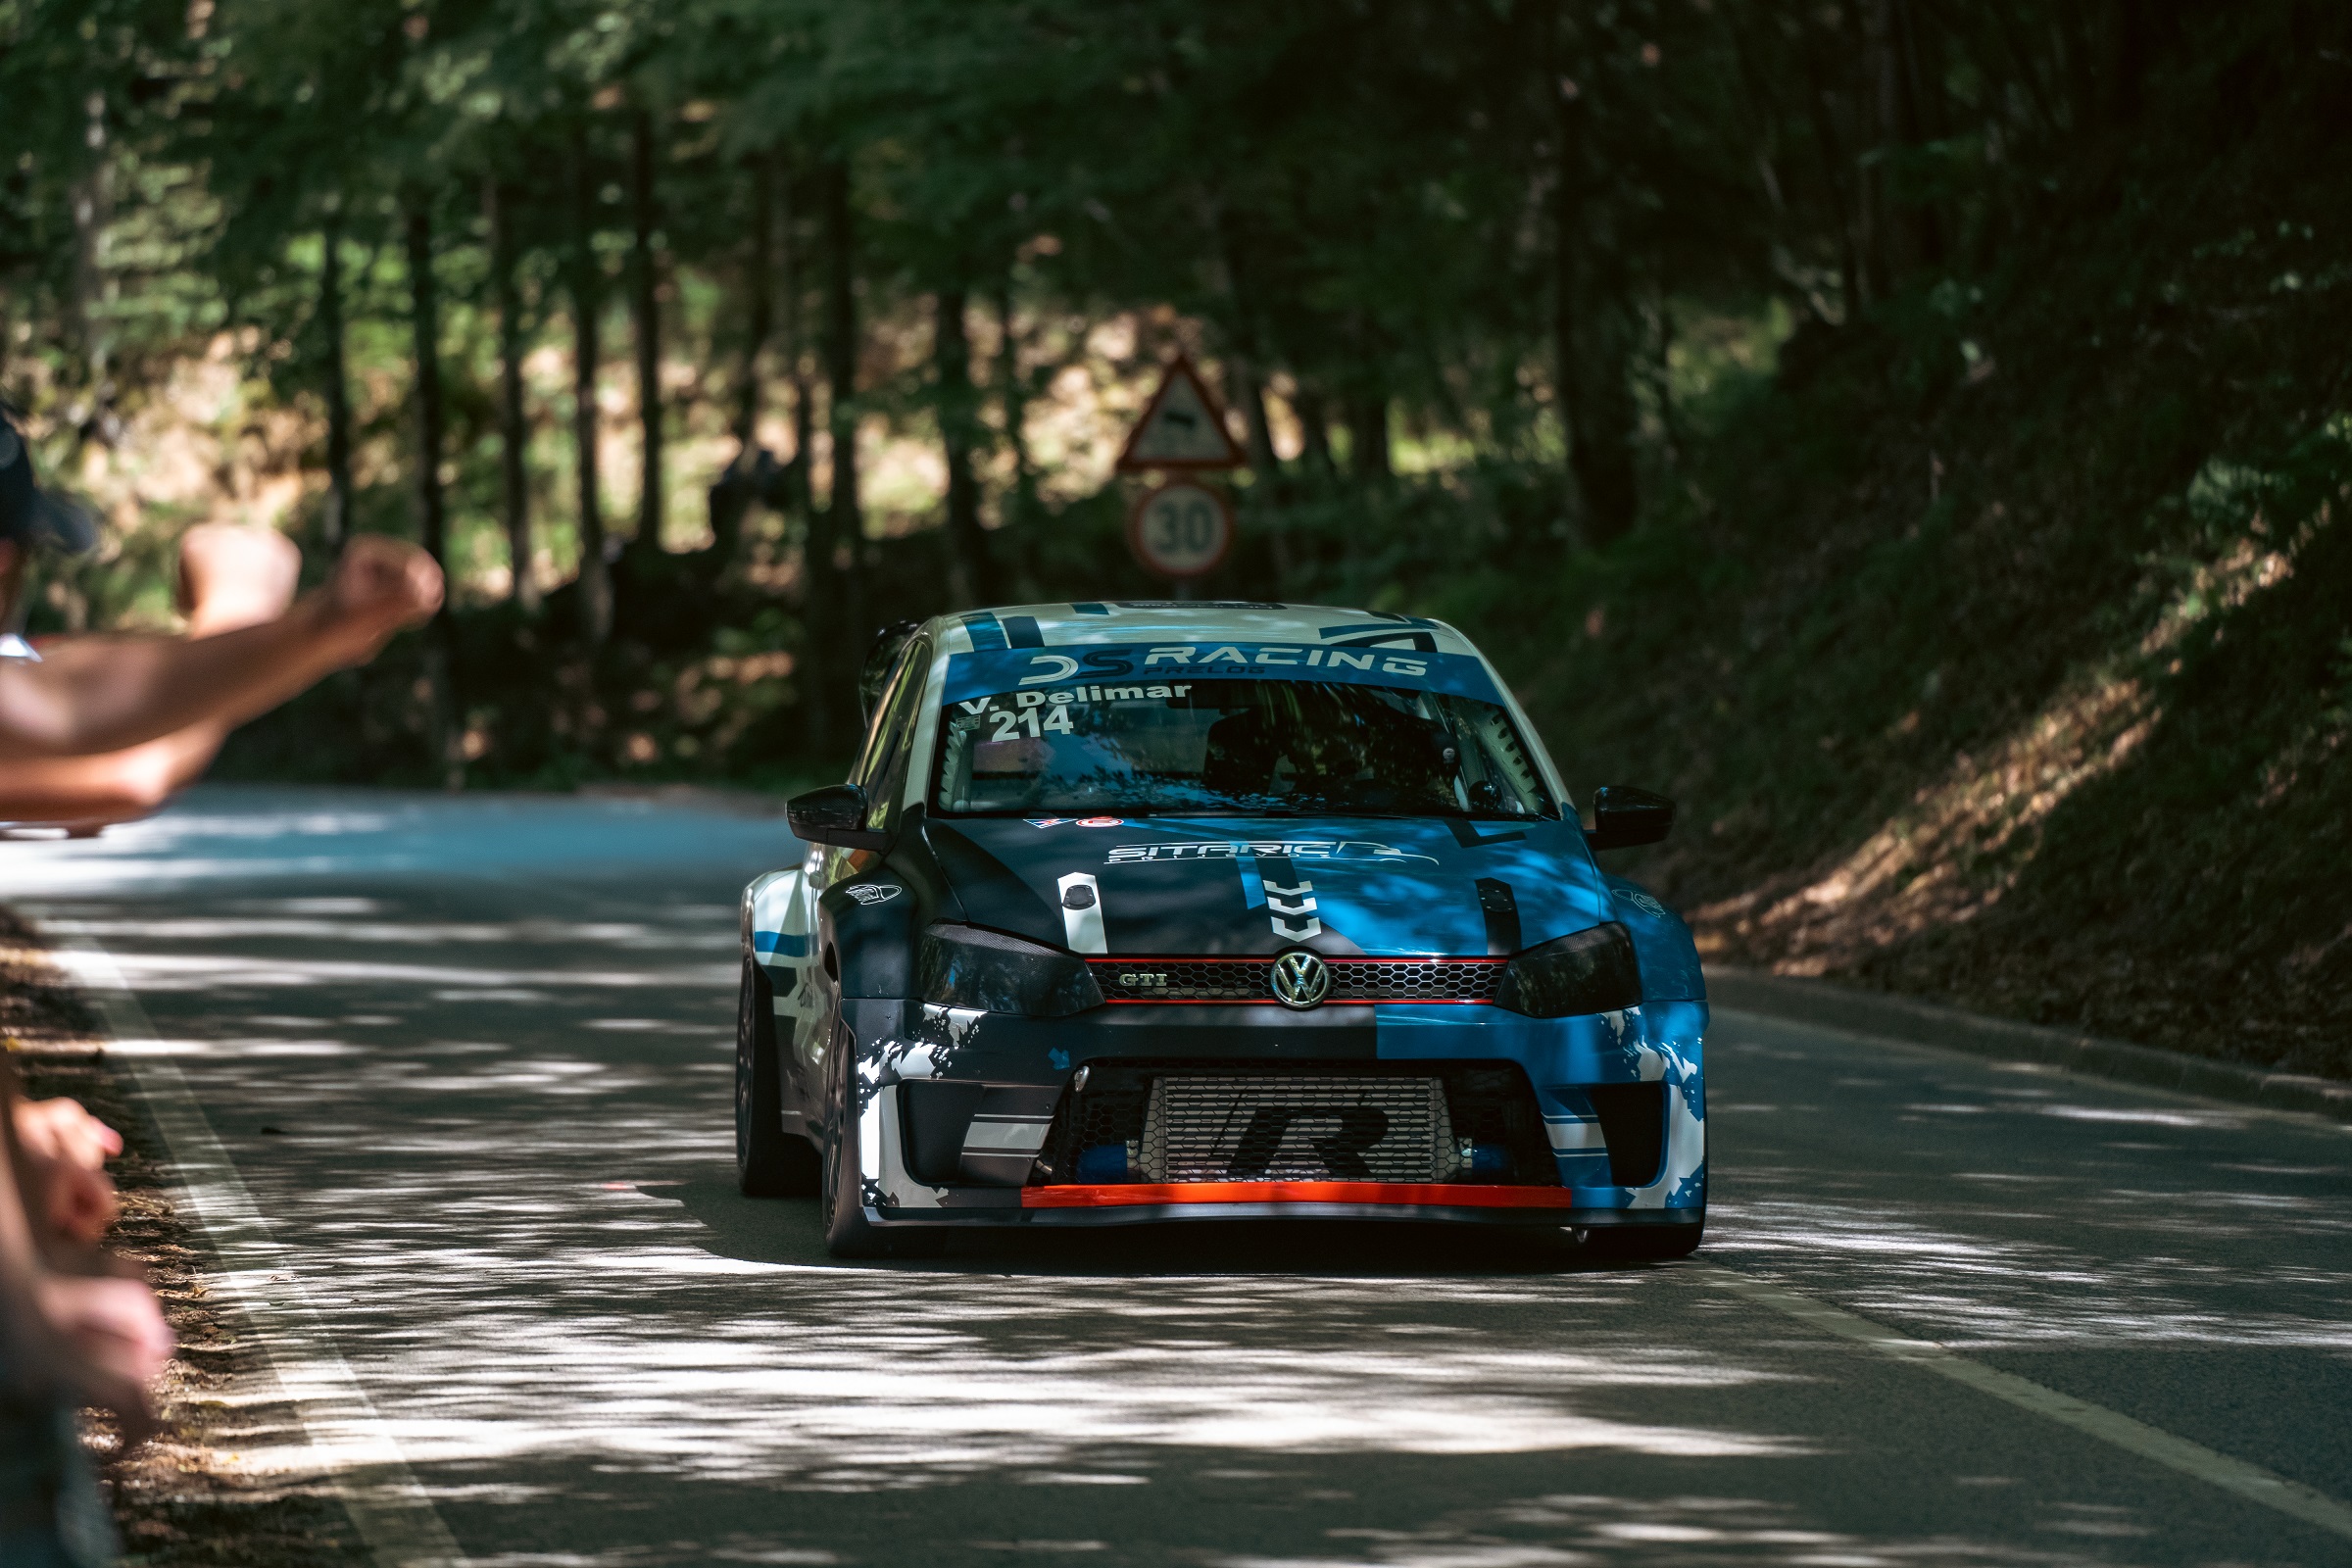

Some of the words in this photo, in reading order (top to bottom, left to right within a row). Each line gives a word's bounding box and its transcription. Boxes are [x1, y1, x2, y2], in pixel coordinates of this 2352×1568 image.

[1155, 500, 1212, 555] 30
[1144, 665, 1265, 674] PRELOG
[1145, 647, 1427, 675] RACING
[958, 697, 999, 714] V.
[1016, 686, 1192, 709] Delimar
[989, 705, 1073, 743] 214
[1118, 973, 1167, 987] GTI
